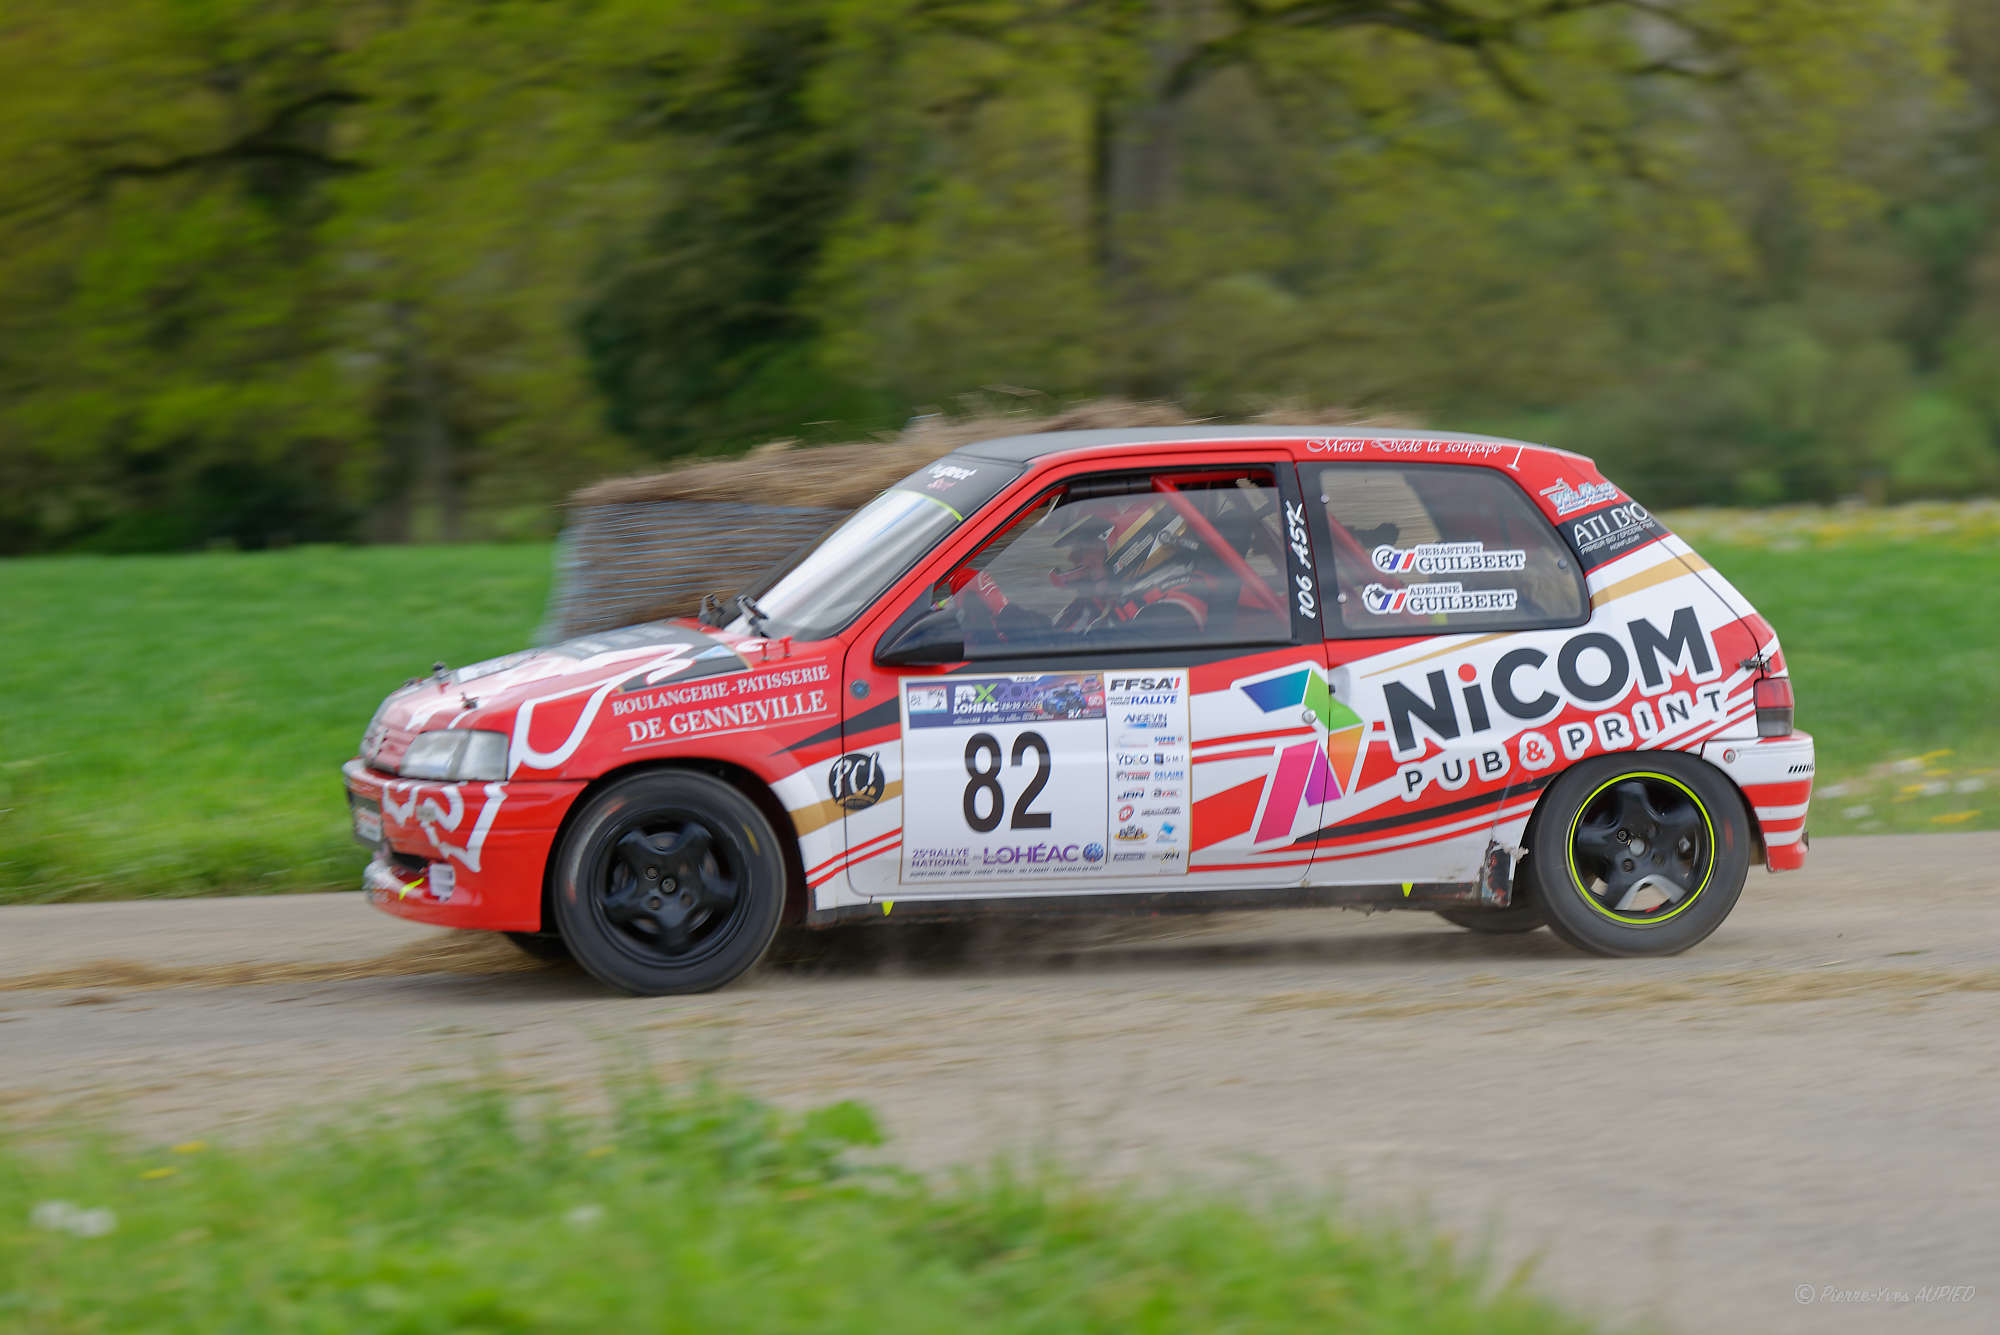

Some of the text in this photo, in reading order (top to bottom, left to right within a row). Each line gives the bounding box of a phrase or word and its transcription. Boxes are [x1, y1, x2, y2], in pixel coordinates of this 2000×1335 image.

[1574, 514, 1611, 547] ATI
[1417, 545, 1481, 556] SEBASTIEN
[1419, 553, 1525, 571] GUILBERT
[1295, 573, 1316, 620] 106
[1409, 585, 1461, 595] ADELINE
[1410, 593, 1516, 611] GUILBERT
[1110, 677, 1172, 692] FFSA
[1130, 695, 1178, 705] RALLYE
[627, 690, 828, 743] DE GENNEVILLE
[1404, 690, 1721, 793] PUB & PRINT
[963, 730, 1052, 834] 82
[983, 843, 1080, 865] LOHÉAC
